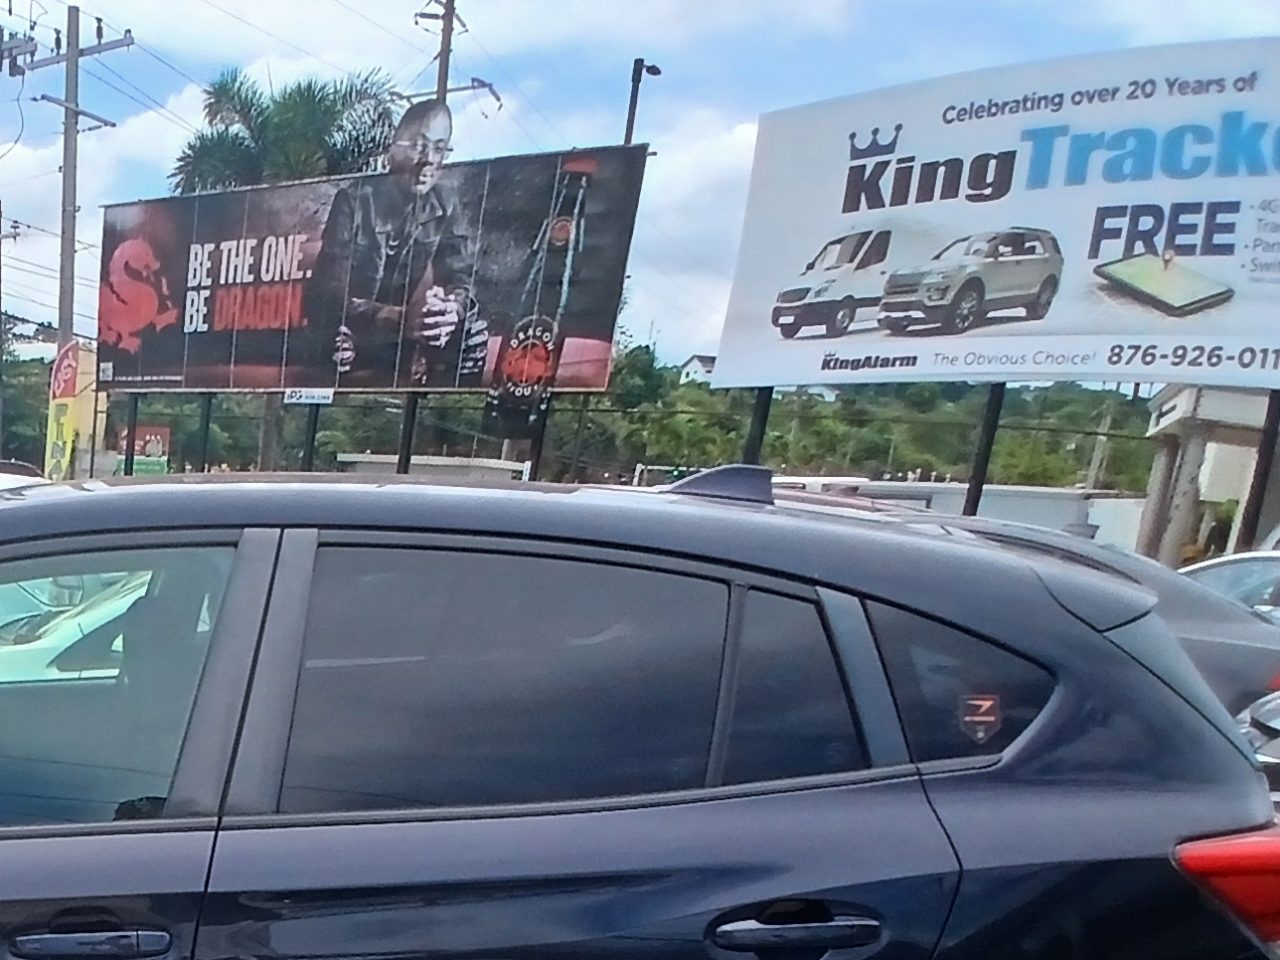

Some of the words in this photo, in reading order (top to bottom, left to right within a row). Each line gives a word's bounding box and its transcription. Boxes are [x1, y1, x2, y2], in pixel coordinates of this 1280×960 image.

[942, 90, 1064, 124] Celebrating
[1070, 86, 1120, 106] over
[1126, 79, 1157, 100] 20
[1164, 74, 1226, 96] Years
[1232, 71, 1258, 92] of
[842, 110, 1280, 214] KingTrack
[1088, 200, 1241, 260] FREE
[187, 243, 215, 288] BE
[220, 239, 258, 284] THE
[260, 234, 312, 282] ONE.
[184, 289, 210, 333] BE
[214, 284, 308, 331] DRAGON.
[510, 326, 554, 352] DRAGON
[821, 355, 918, 371] KingAlarm
[933, 352, 959, 367] The
[963, 351, 1027, 367] Obvious
[1032, 350, 1097, 366] Choice!
